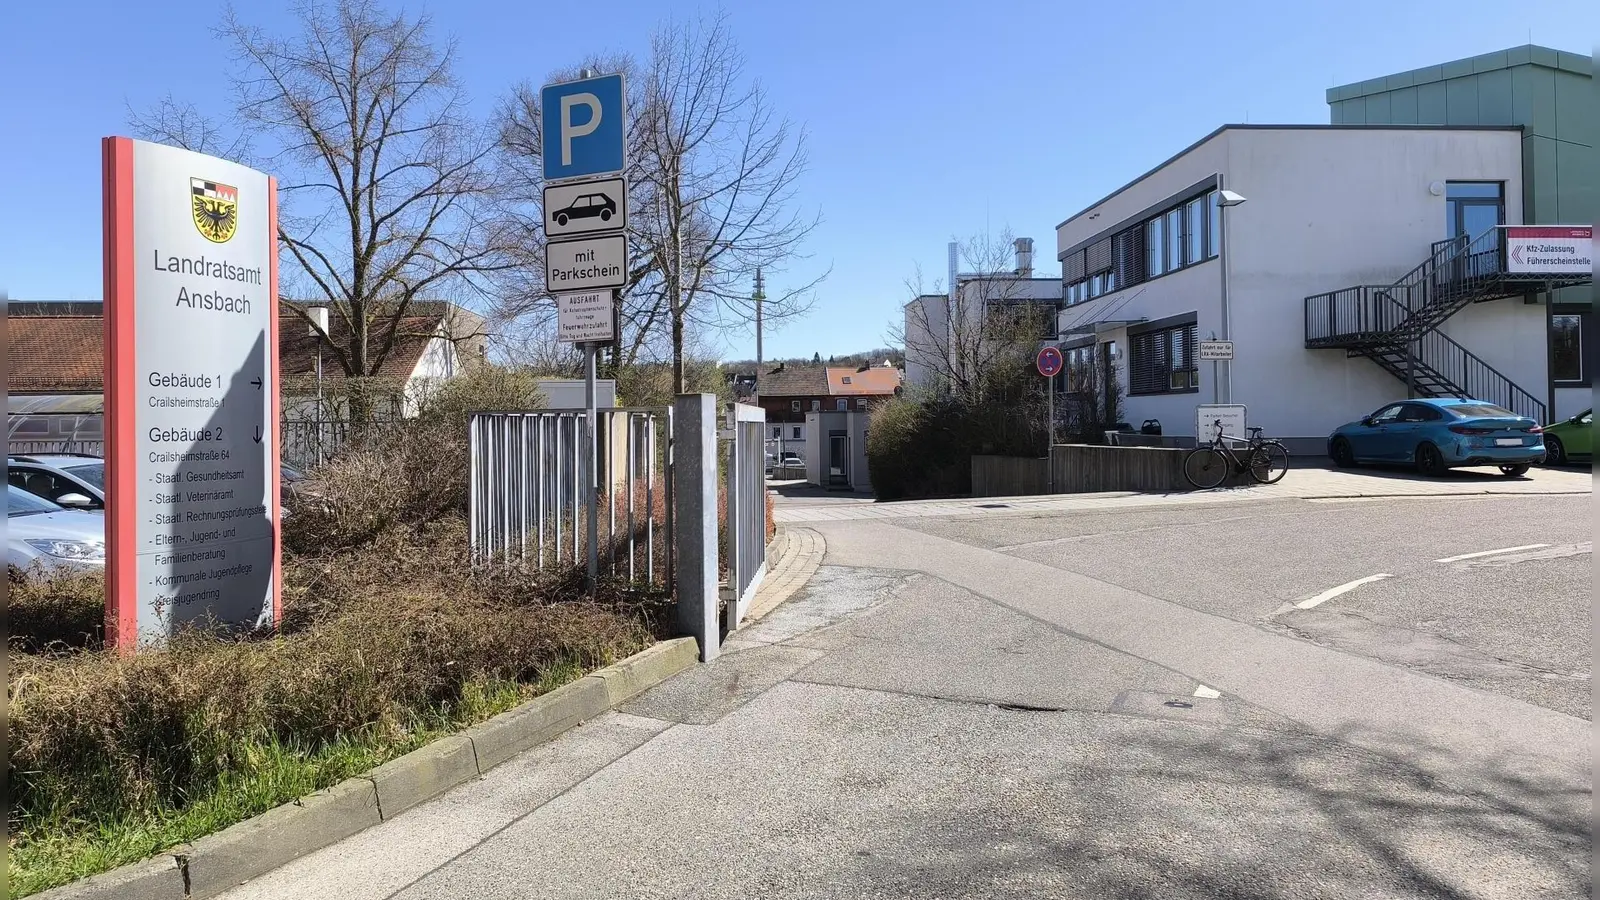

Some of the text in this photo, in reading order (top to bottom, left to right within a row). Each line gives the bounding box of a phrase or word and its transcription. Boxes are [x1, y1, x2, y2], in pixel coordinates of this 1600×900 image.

[560, 92, 603, 167] P
[575, 249, 595, 264] mit
[1526, 244, 1575, 255] Kfz-Zulassung
[154, 249, 262, 286] Landratsamt
[1527, 256, 1591, 266] Führerscheinstelle
[552, 263, 621, 282] Parkschein
[176, 286, 251, 315] Ansbach
[569, 294, 600, 304] AUSFAHRT
[562, 322, 608, 330] Feuerwehrzufahrt
[149, 371, 222, 389] Gebäude 1
[149, 396, 220, 409] Crailsheimstraße
[149, 426, 223, 443] Gebäude 2
[149, 449, 230, 463] Crailsheimstraße 64
[155, 469, 245, 484] Staatl. Gesundheitsamt
[155, 489, 235, 505] Staatl. Veterinäramt
[155, 512, 184, 525] Staatl.
[155, 527, 236, 546] Eltern-, Jugend- und
[154, 548, 226, 566] Familienberatung
[155, 564, 253, 587] Kommunale Jugendpflege
